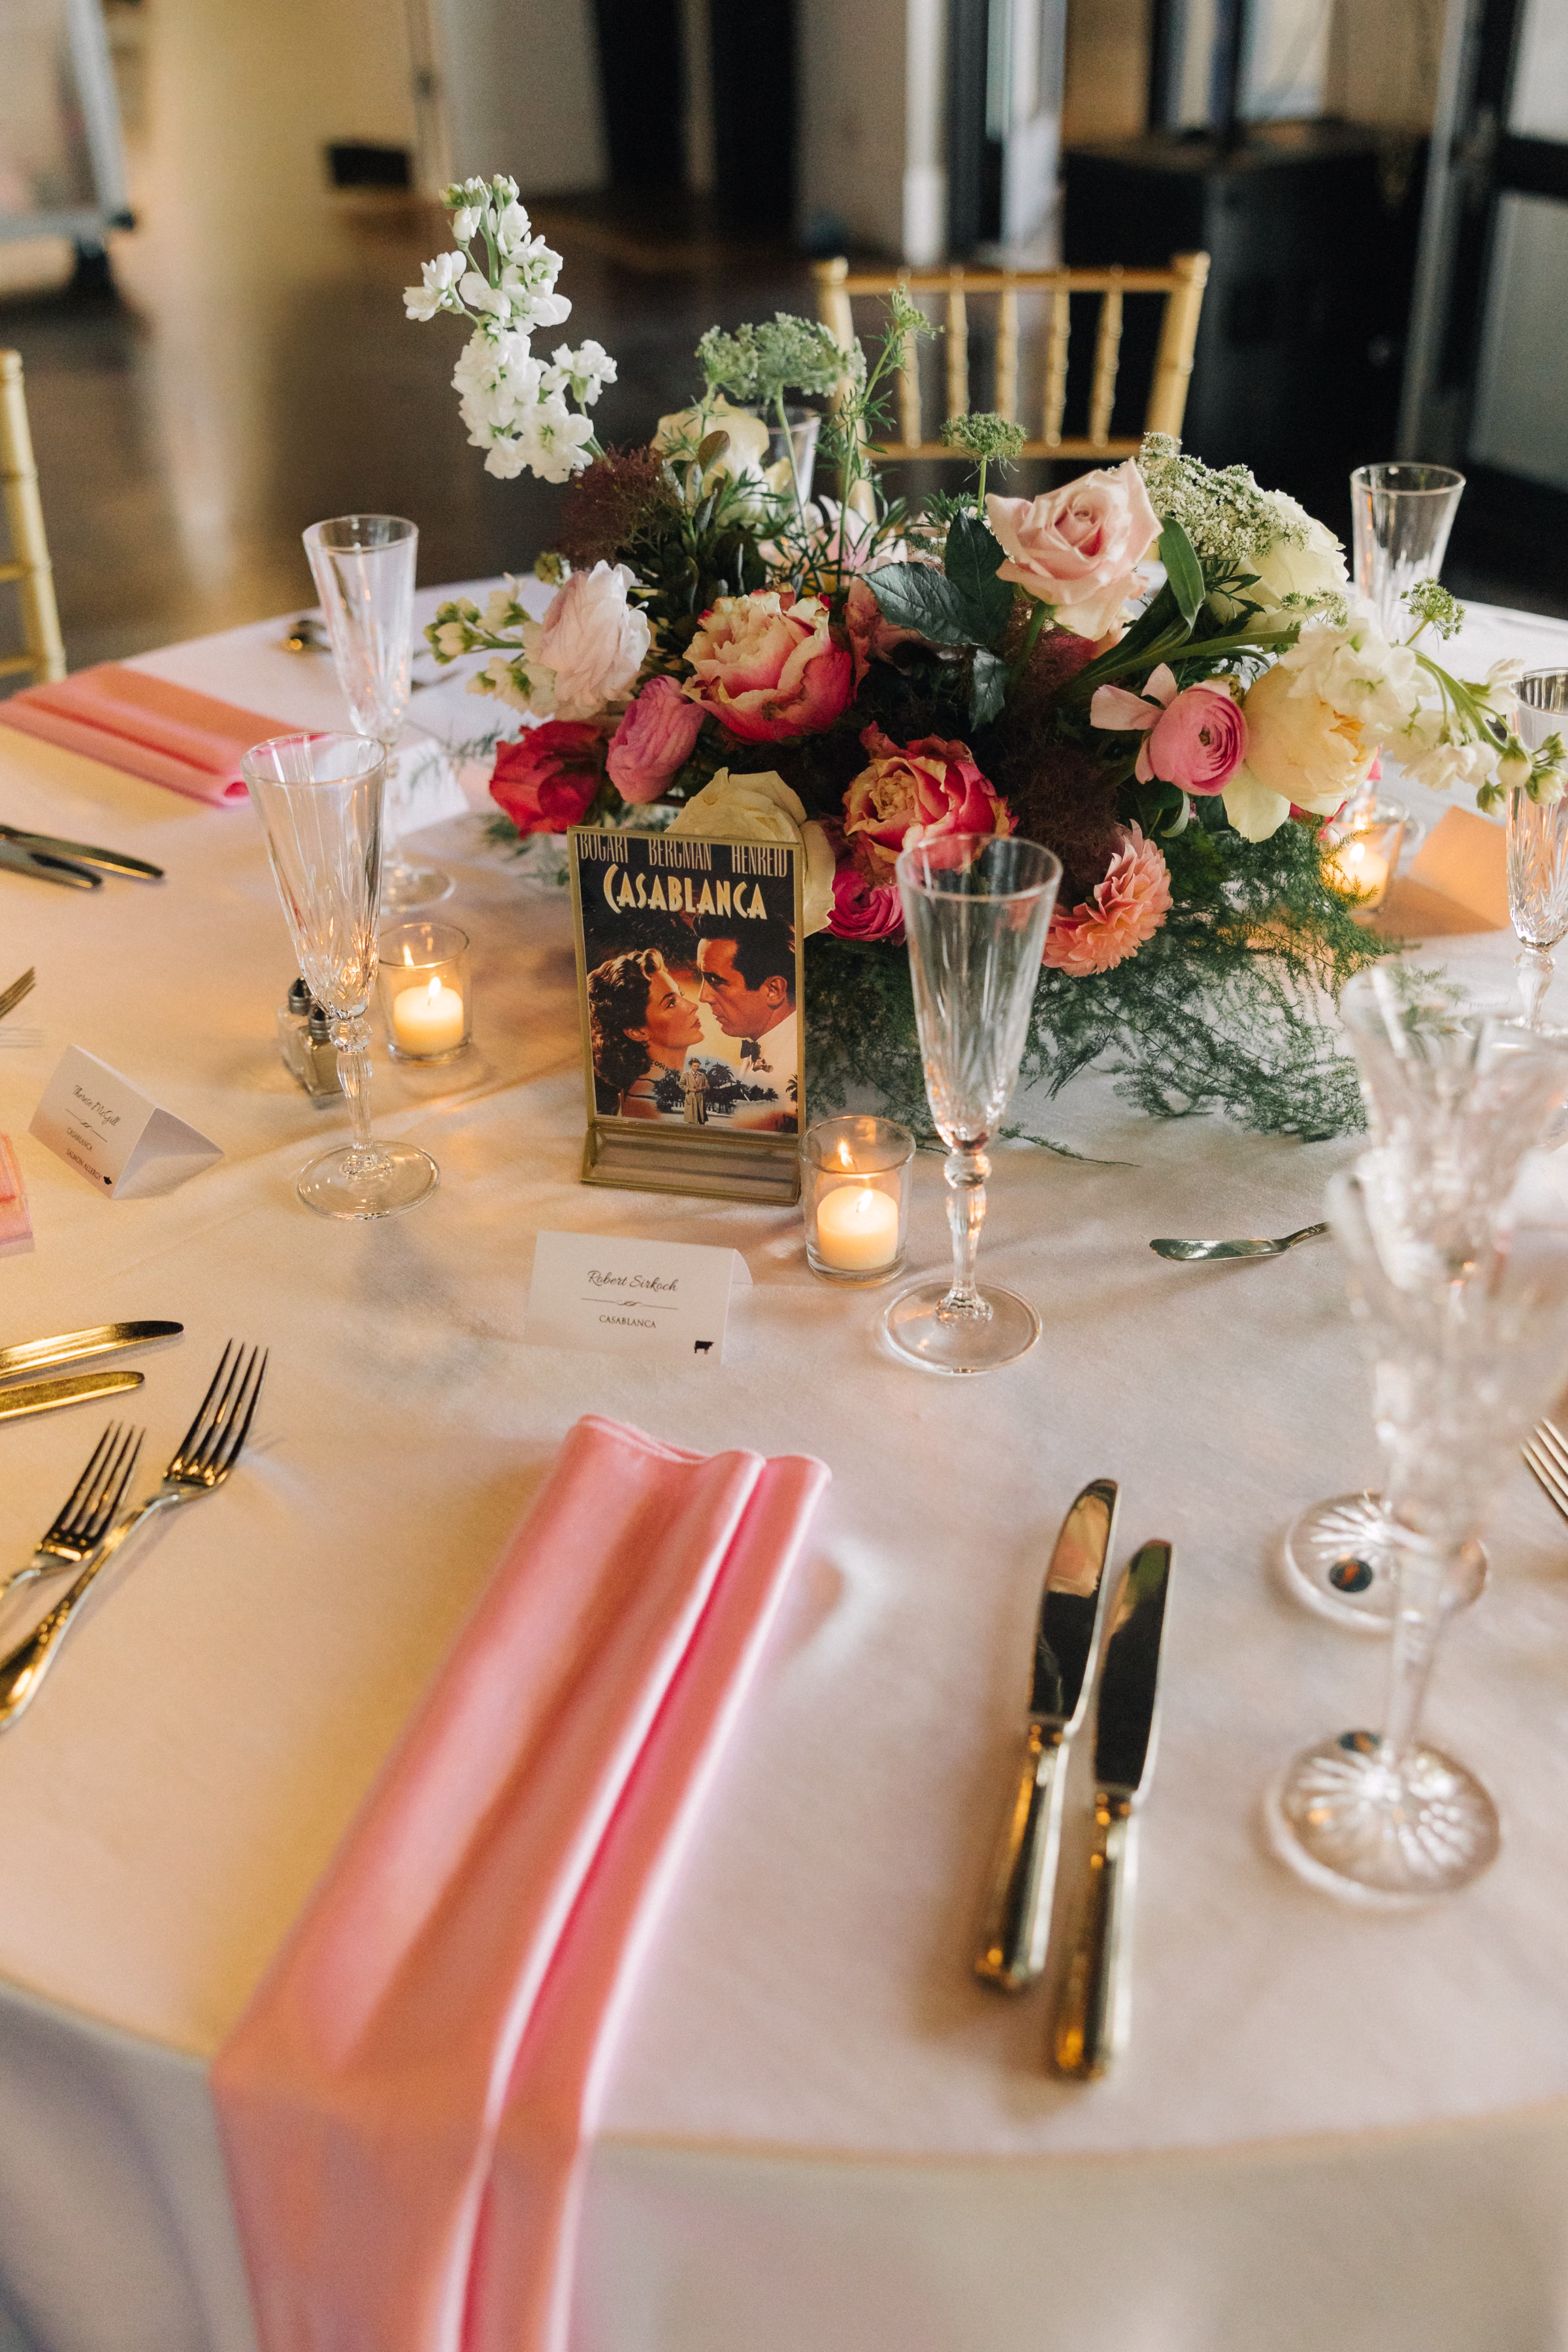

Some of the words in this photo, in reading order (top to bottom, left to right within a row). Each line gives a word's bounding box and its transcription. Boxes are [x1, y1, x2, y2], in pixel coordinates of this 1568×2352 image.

[580, 834, 629, 863] BOGART
[648, 839, 712, 871] BERGMAN
[731, 845, 788, 877] HENREID
[604, 864, 768, 920] CASABLANCA
[91, 1102, 121, 1126] McGill
[67, 1127, 93, 1151] CASABLANCA
[67, 1149, 84, 1166] SALMON
[84, 1162, 102, 1181] ALLERGY
[587, 1270, 628, 1286] Robert
[599, 1315, 657, 1328] CASABLANCA
